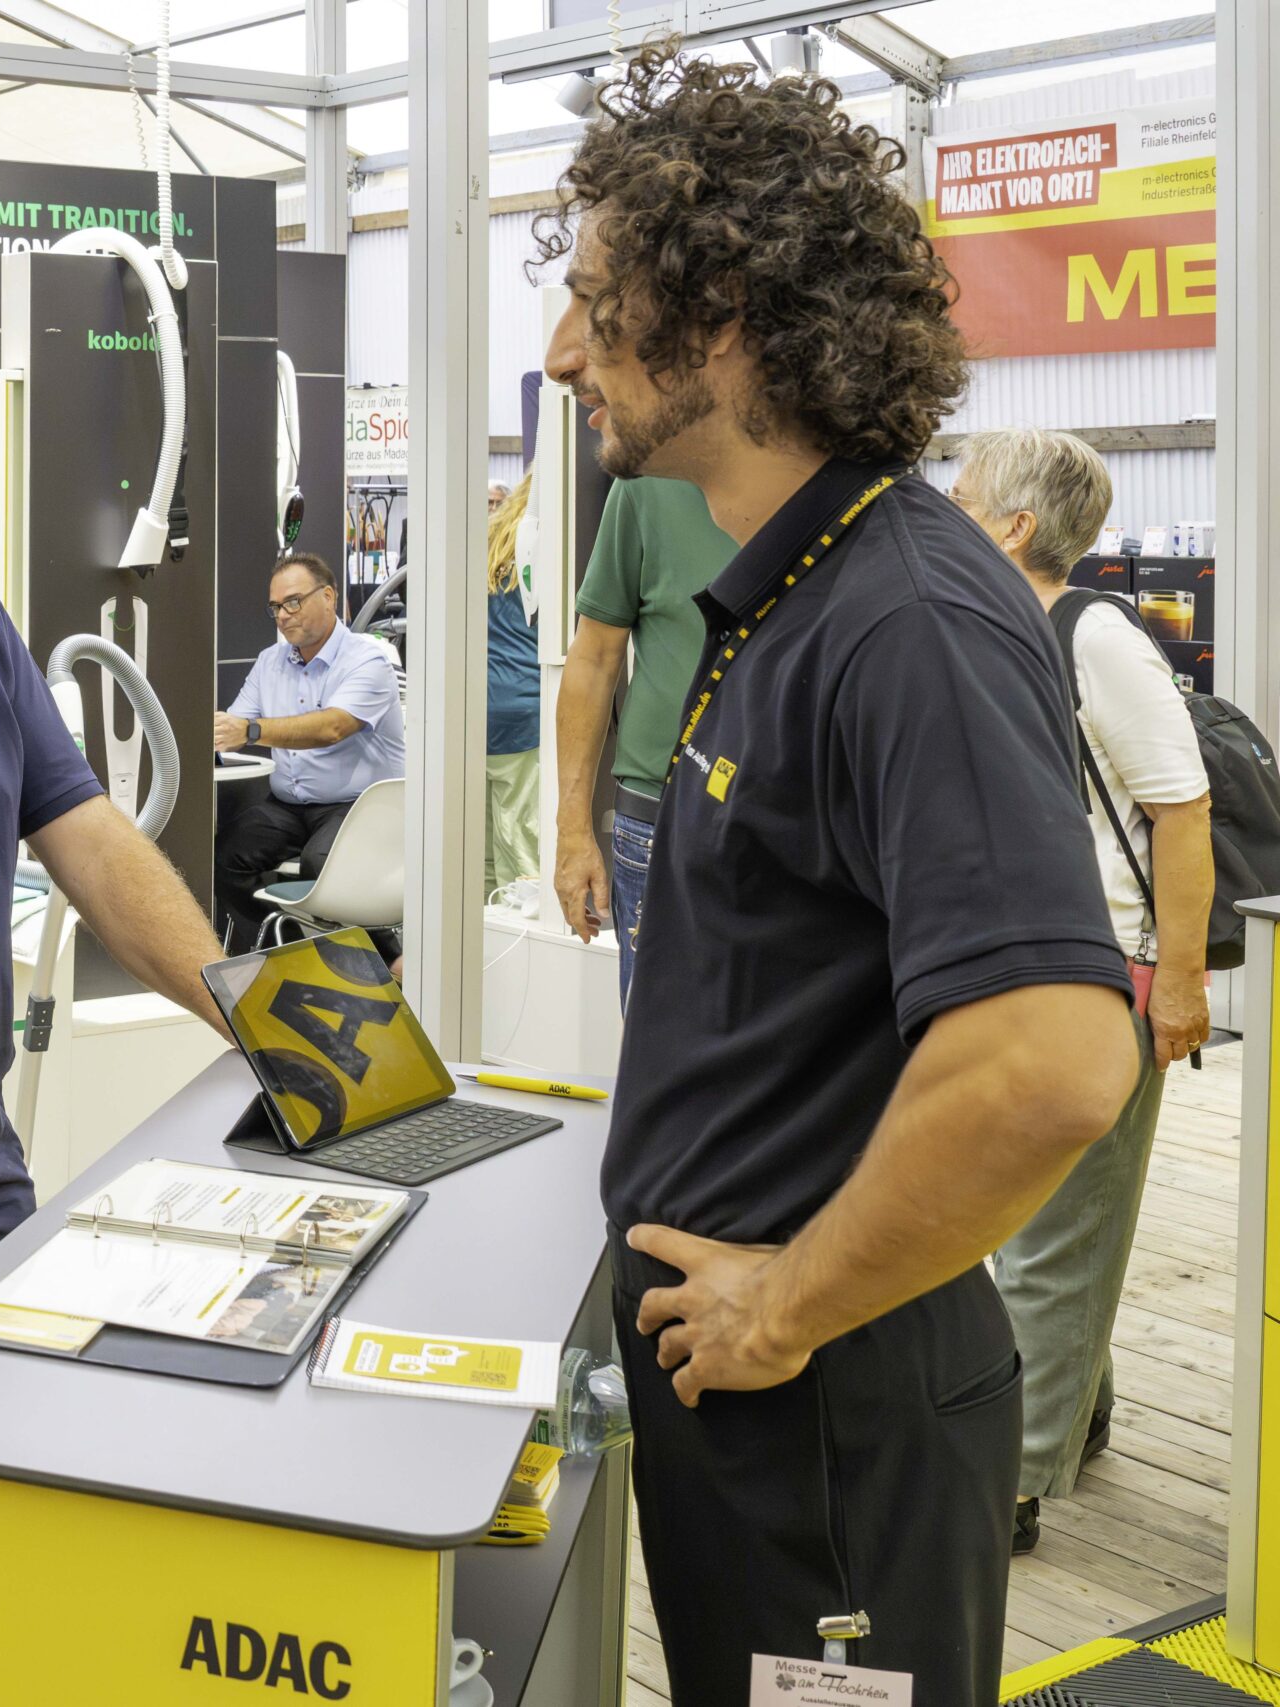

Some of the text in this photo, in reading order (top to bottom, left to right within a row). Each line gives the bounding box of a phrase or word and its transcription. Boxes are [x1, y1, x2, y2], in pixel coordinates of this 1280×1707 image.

[1141, 115, 1207, 133] m-electronics
[1141, 136, 1169, 148] Filiale
[943, 133, 1110, 180] IHR ELEKTROFACH-
[1142, 168, 1209, 186] m-electronics
[940, 170, 1093, 214] MARKT VOR ORT!
[88, 329, 160, 352] kobold
[366, 450, 382, 461] aus
[839, 476, 894, 527] www.adac.de
[680, 692, 712, 745] www.adac.de
[549, 1084, 571, 1095] ADAC
[180, 1615, 352, 1701] ADAC
[775, 1660, 817, 1675] Messe
[798, 1675, 889, 1700] am Hochrhein
